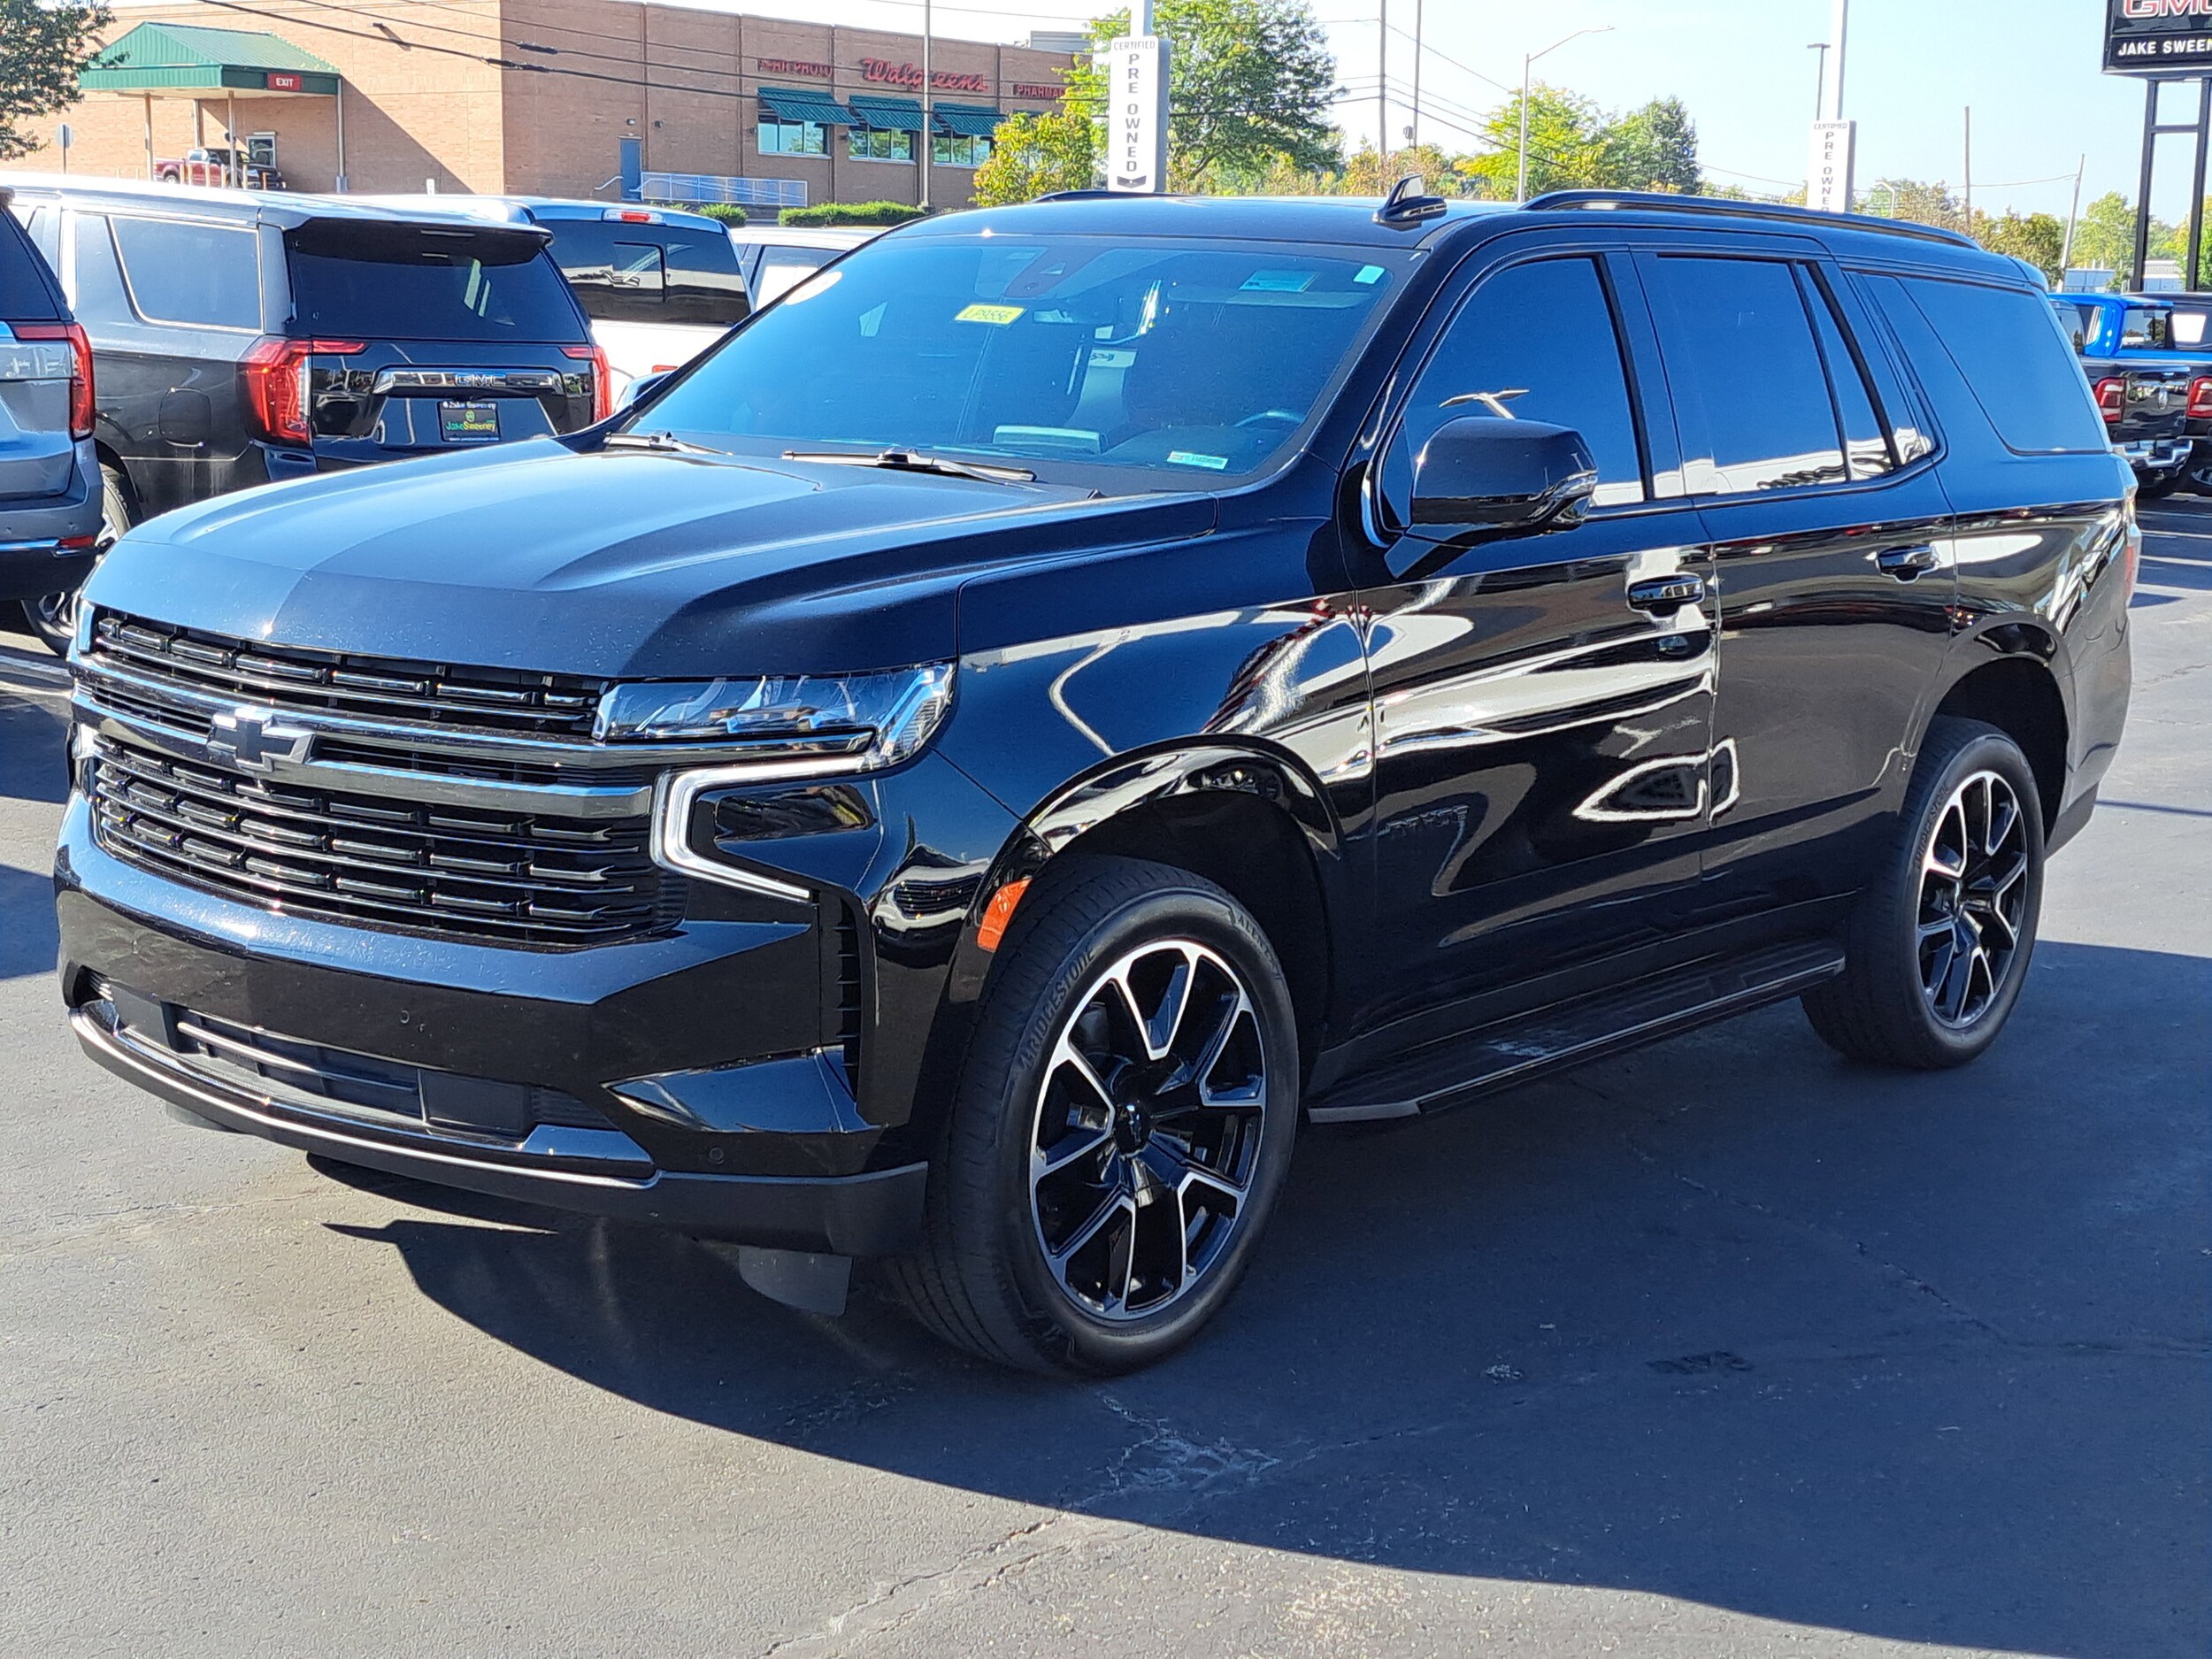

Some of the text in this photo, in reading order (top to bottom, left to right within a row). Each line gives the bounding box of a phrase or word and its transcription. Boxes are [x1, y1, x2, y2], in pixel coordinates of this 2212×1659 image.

[1113, 41, 1156, 51] CERTIFIED
[2117, 42, 2157, 56] JAKE
[276, 77, 294, 88] EXIT
[861, 58, 989, 93] Walgeens
[1016, 84, 1066, 99] PHARMAC
[1125, 53, 1141, 173] PRE OWNED
[1824, 131, 1835, 160] PRE
[455, 373, 507, 388] GMC
